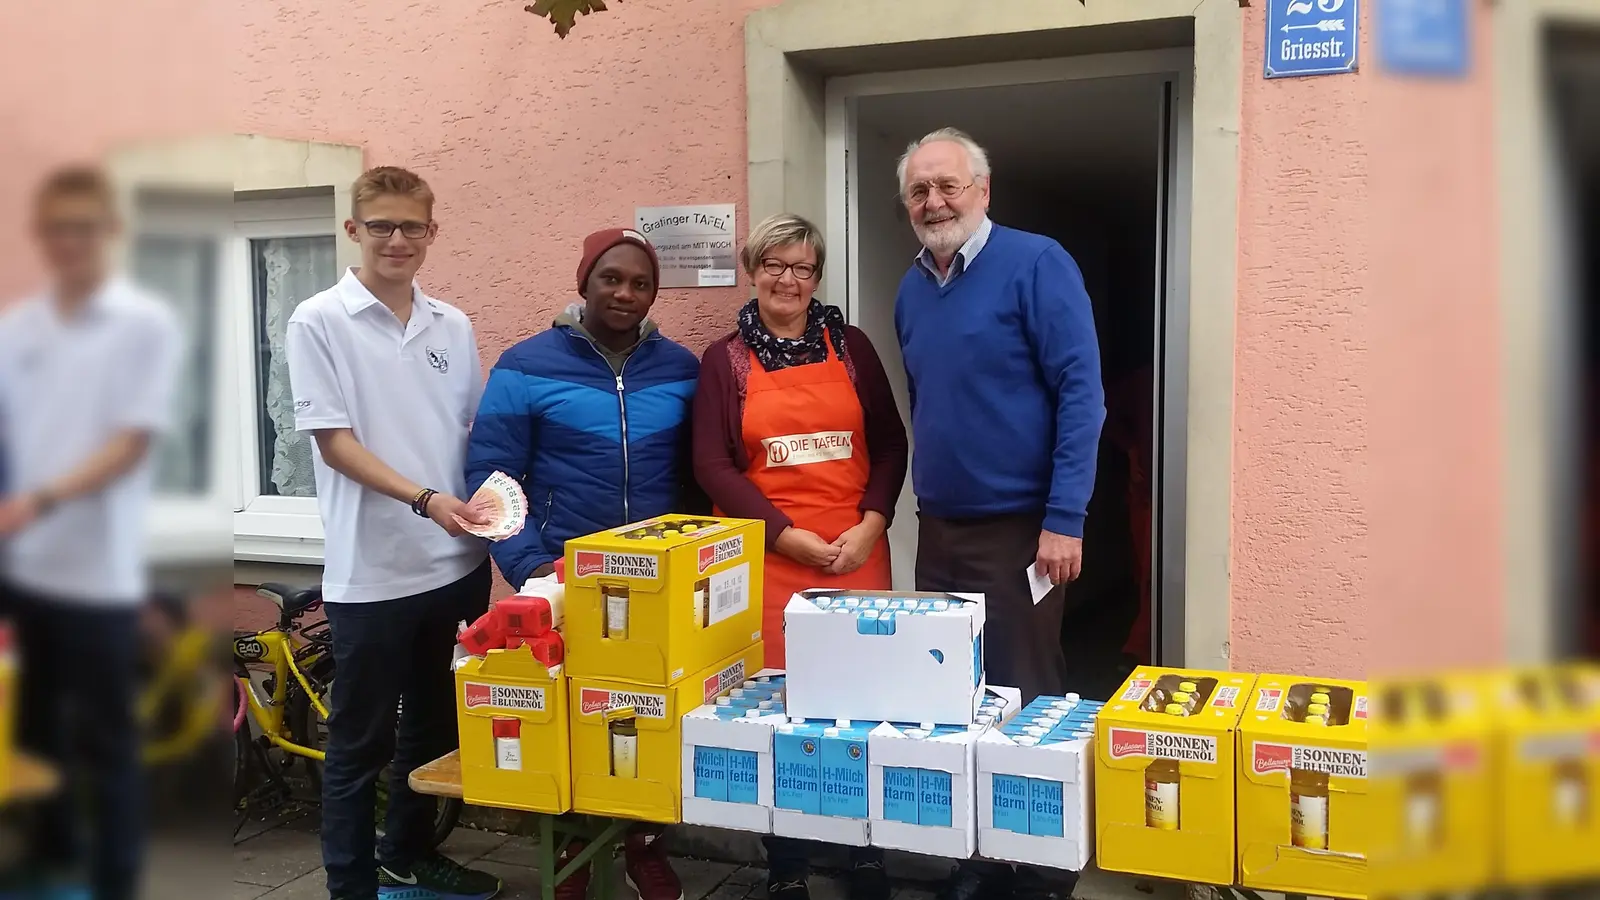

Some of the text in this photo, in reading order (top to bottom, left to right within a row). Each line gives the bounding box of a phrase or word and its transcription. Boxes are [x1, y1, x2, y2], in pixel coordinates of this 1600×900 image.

[1280, 37, 1346, 61] Griesstr.
[693, 213, 727, 231] TAFEL
[790, 436, 850, 452] DIE TAFELN
[611, 555, 656, 568] SONNEN-
[611, 566, 656, 578] BLUMENÖL
[239, 643, 260, 653] 240
[497, 687, 543, 700] SONNEN-
[617, 693, 664, 707] SONNEN-
[497, 698, 543, 709] BLUMENÖL
[1155, 734, 1214, 750] SONNEN-
[1155, 746, 1214, 761] BLUMENÖL
[1303, 748, 1367, 766] SONNEN-
[777, 762, 817, 779] H-Milch
[823, 766, 864, 784] H-Milch
[777, 776, 818, 792] fettarm
[823, 781, 864, 797] fettarm
